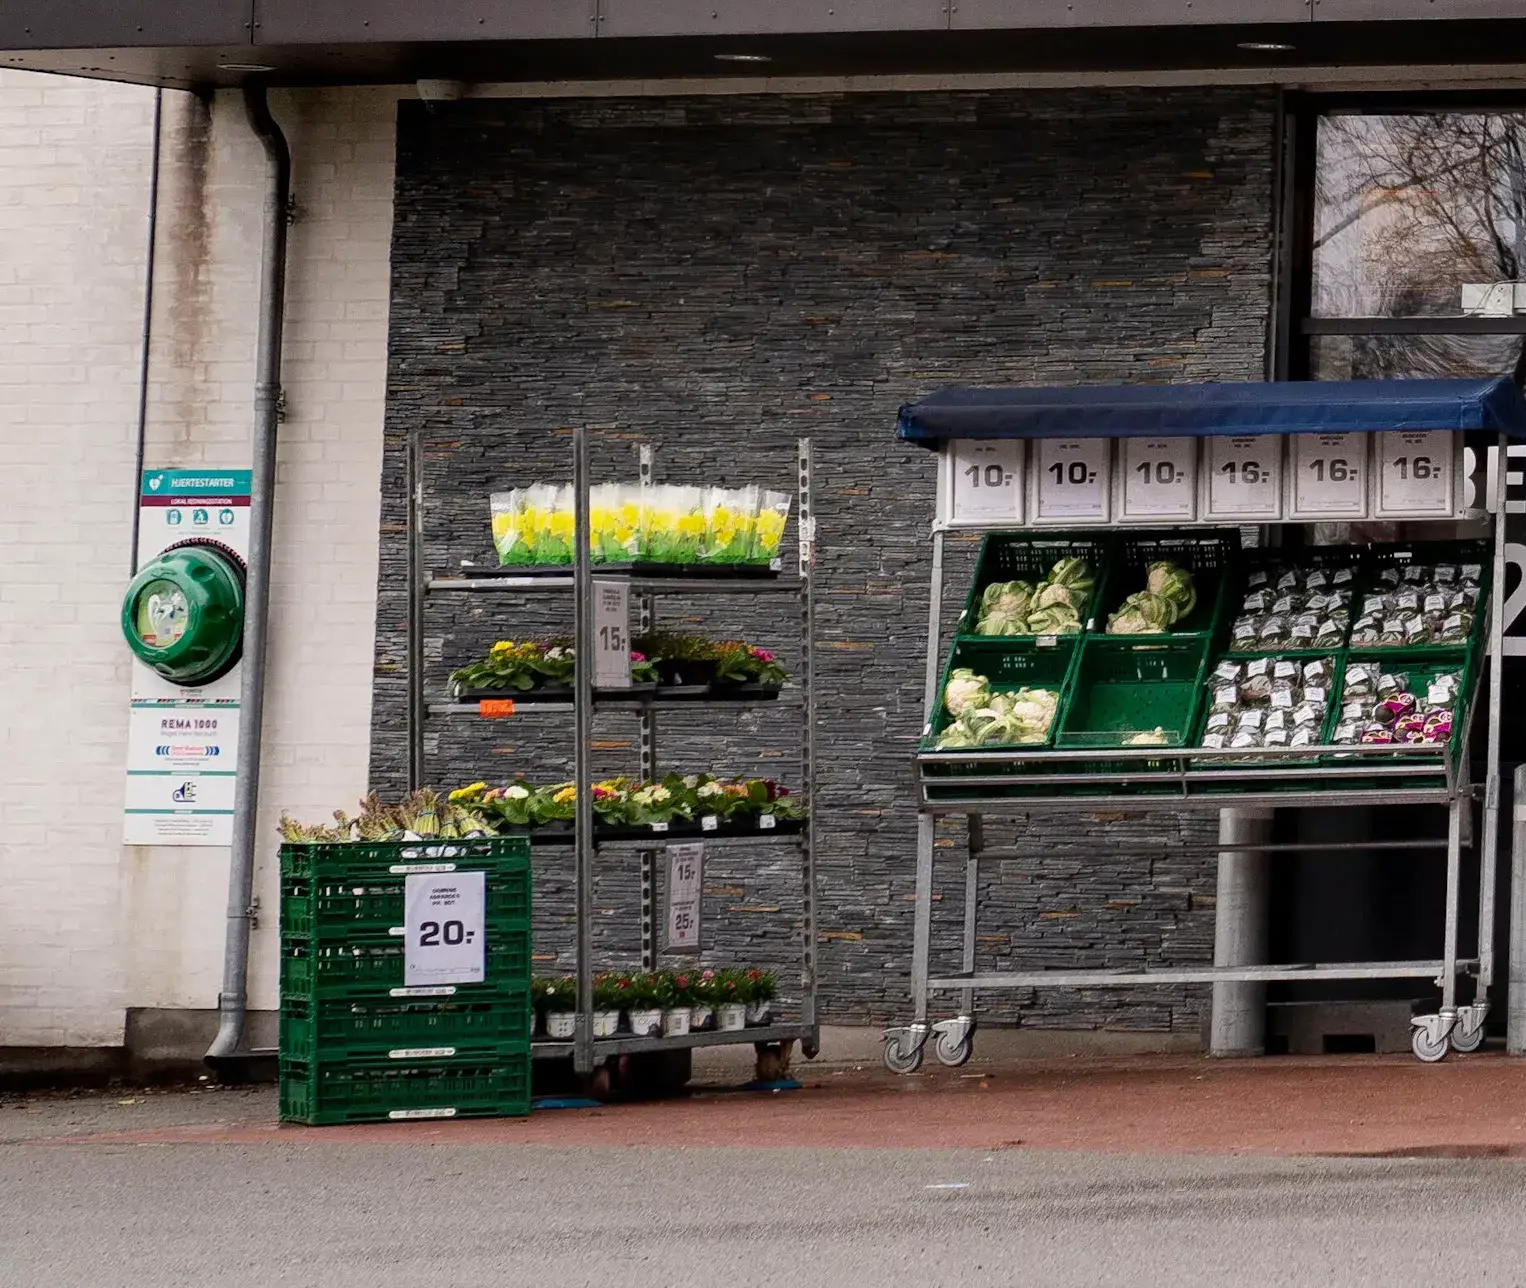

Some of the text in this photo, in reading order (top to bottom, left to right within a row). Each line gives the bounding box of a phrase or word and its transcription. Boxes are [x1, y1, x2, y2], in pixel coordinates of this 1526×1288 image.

[170, 478, 234, 488] HJERTESTARTER
[161, 719, 218, 729] REMA 1000
